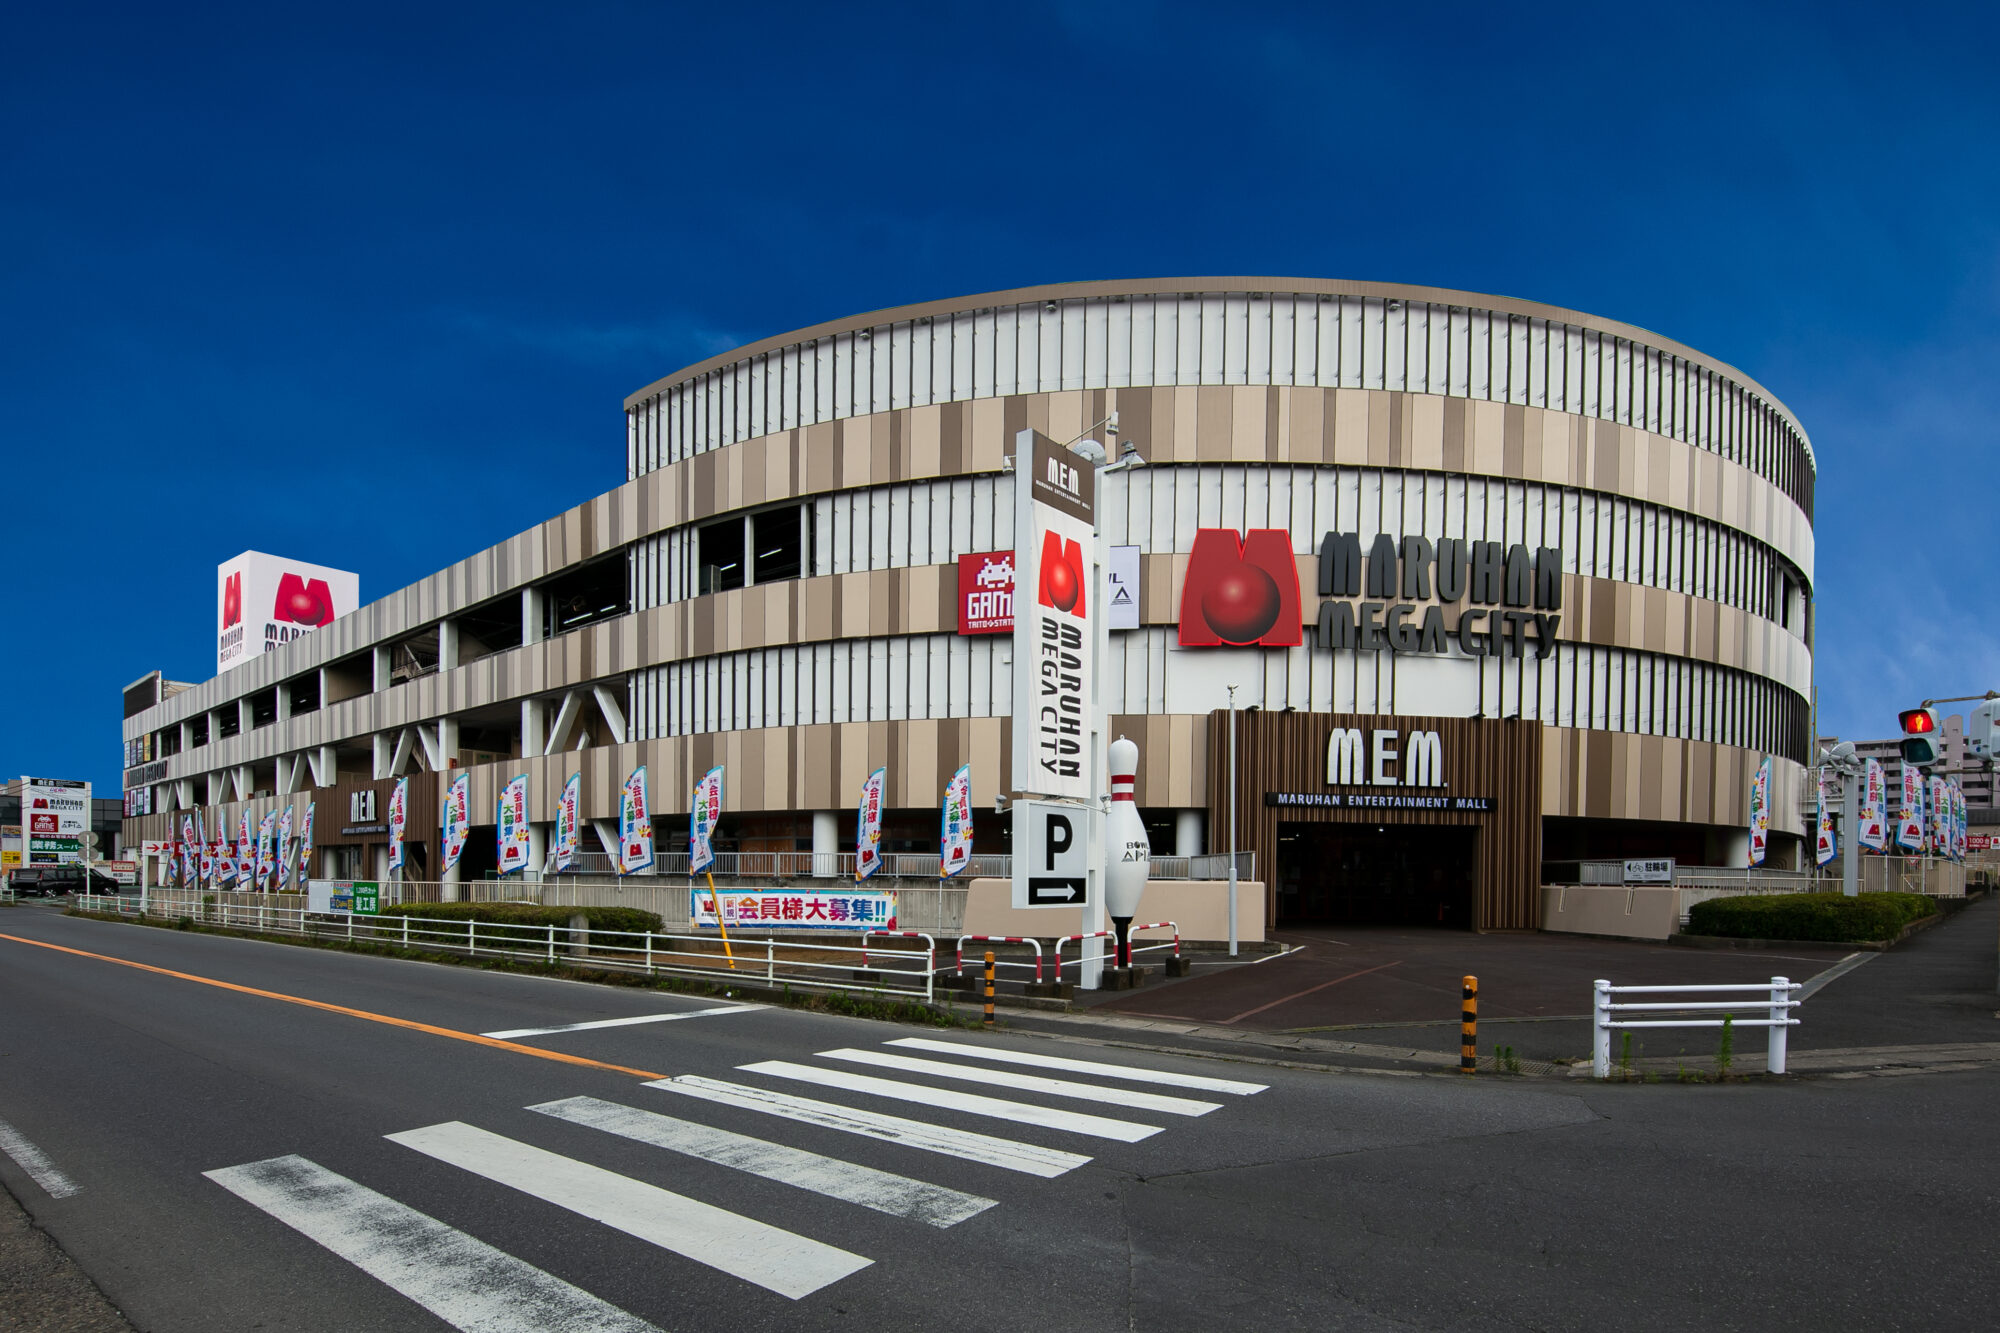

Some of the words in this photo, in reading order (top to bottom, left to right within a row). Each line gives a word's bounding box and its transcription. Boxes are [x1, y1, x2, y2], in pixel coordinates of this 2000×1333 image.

[1318, 530, 1562, 610] MARUHAN
[220, 626, 243, 651] MARUHAN
[1041, 617, 1059, 697] MEGA
[1317, 600, 1448, 654] MEGA
[1459, 607, 1561, 660] CITY
[1059, 622, 1082, 778] MARUHAN
[1040, 705, 1058, 775] CITY
[34, 822, 55, 830] GAME
[1277, 793, 1340, 806] MARUHAN
[1348, 795, 1449, 808] ENTERTAINMENT
[1456, 797, 1488, 809] MALL
[1046, 813, 1074, 871] P
[1644, 861, 1669, 872] 駐輪場
